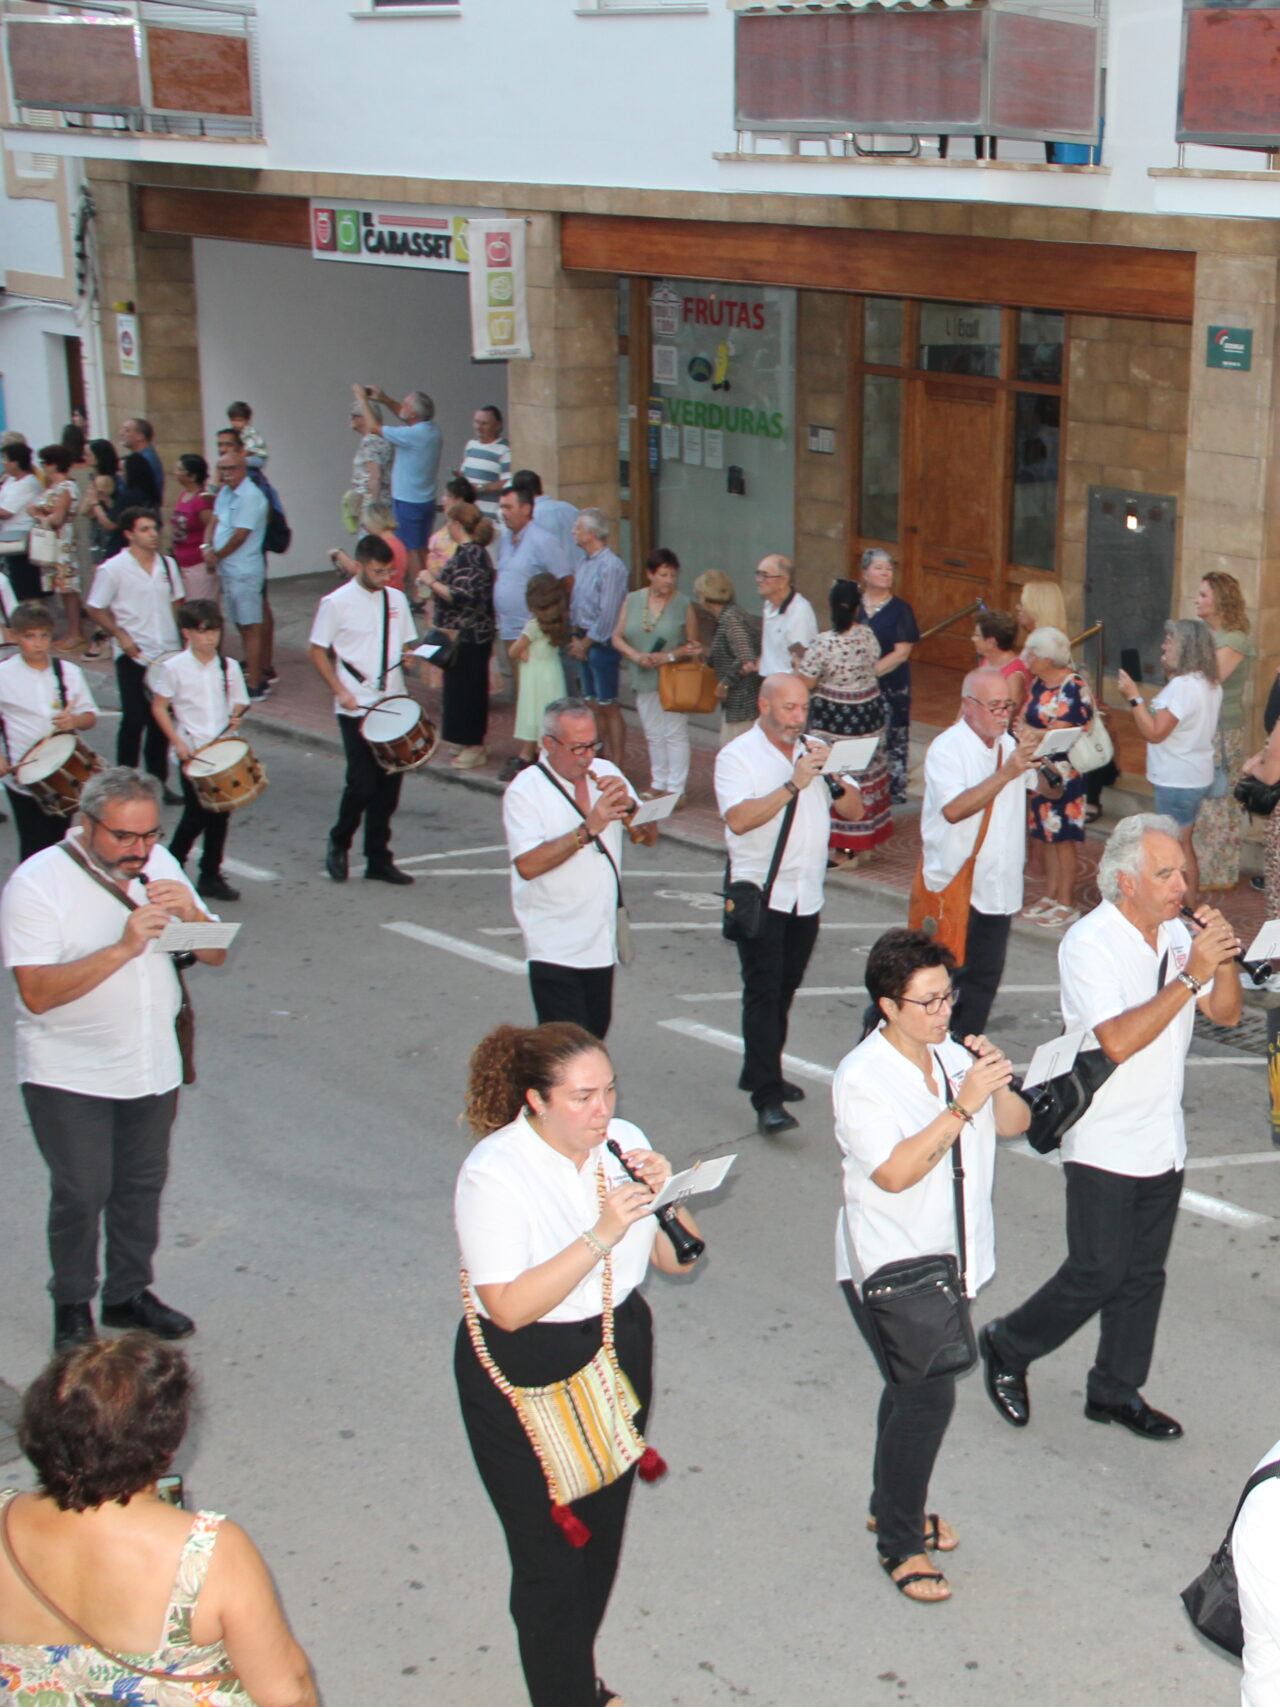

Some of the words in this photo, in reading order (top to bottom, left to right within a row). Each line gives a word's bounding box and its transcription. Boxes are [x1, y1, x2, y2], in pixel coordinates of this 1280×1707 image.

[364, 229, 453, 259] CABASSET
[682, 297, 765, 330] FRUTAS
[667, 398, 785, 439] VERDURAS
